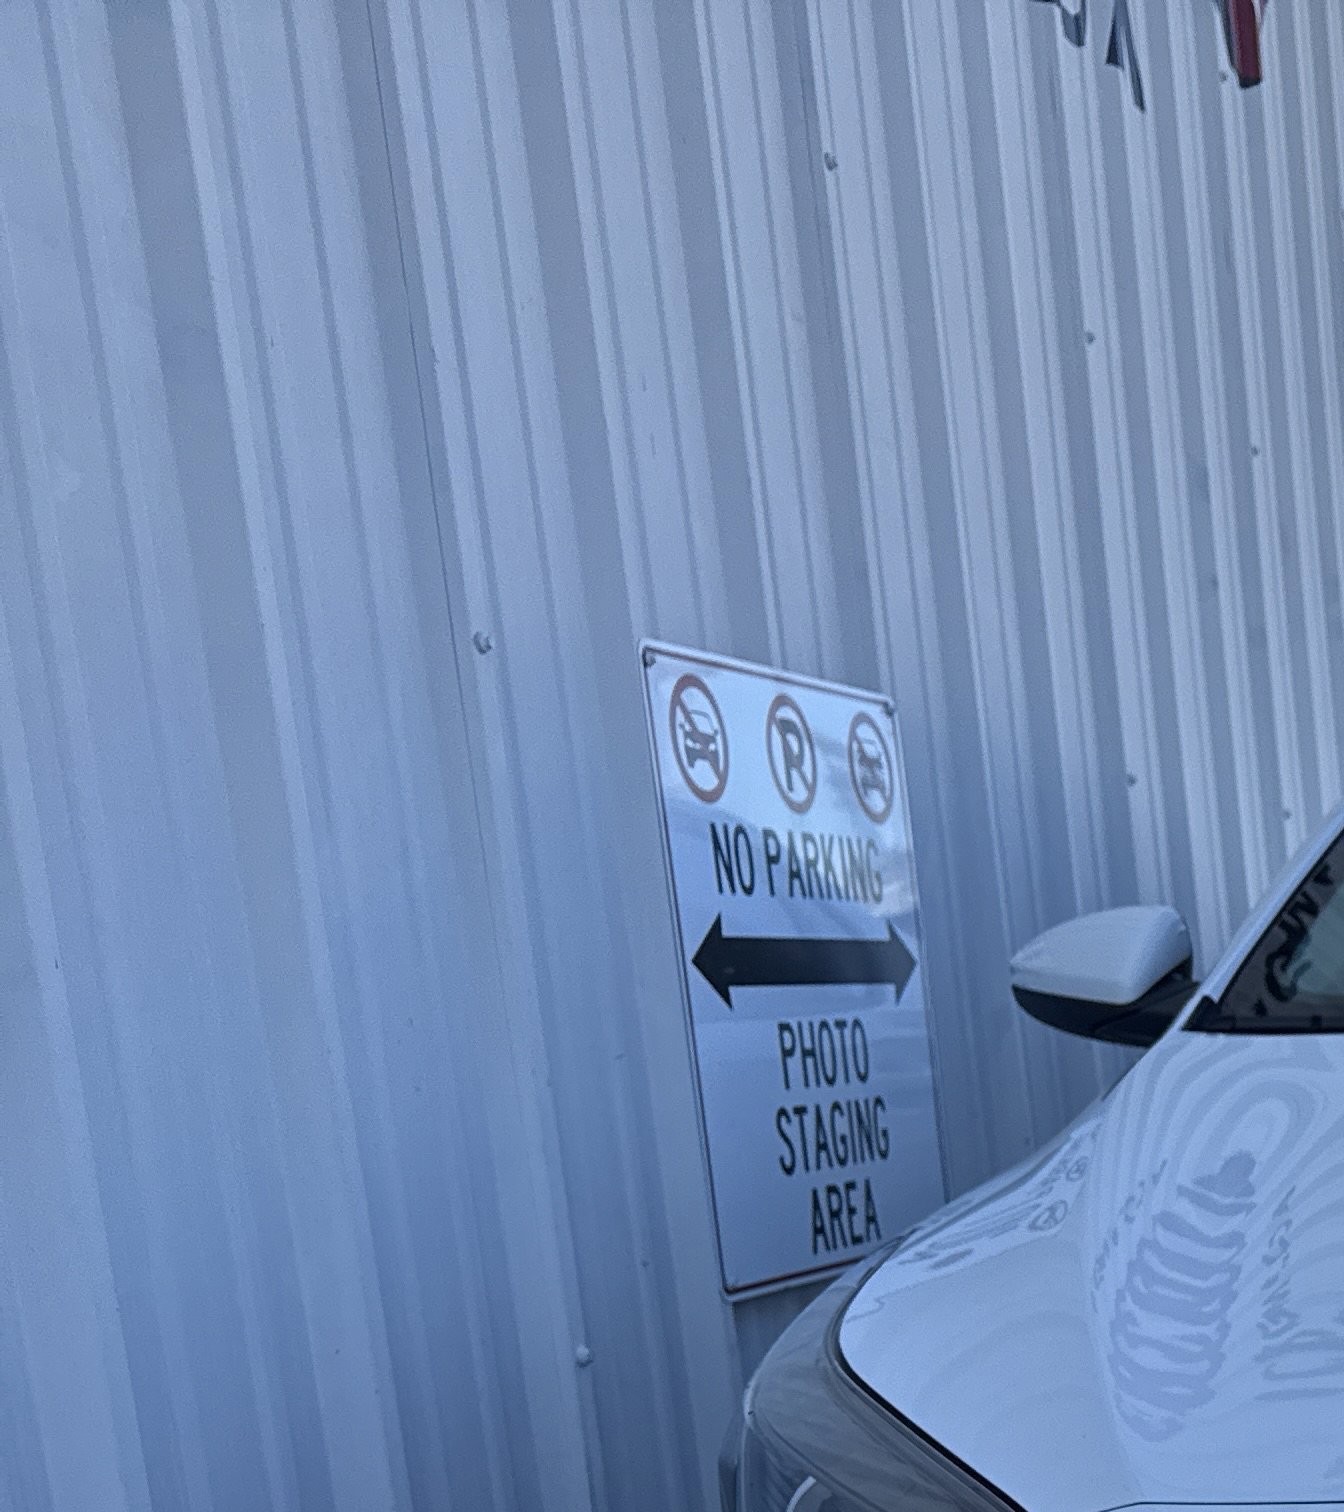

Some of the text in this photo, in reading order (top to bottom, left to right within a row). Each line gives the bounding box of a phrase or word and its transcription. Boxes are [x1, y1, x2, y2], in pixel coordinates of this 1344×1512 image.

[710, 821, 882, 904] NO PARKING
[777, 1017, 869, 1091] PHOTO
[776, 1095, 889, 1176] STAGING
[811, 1178, 881, 1255] AREA
